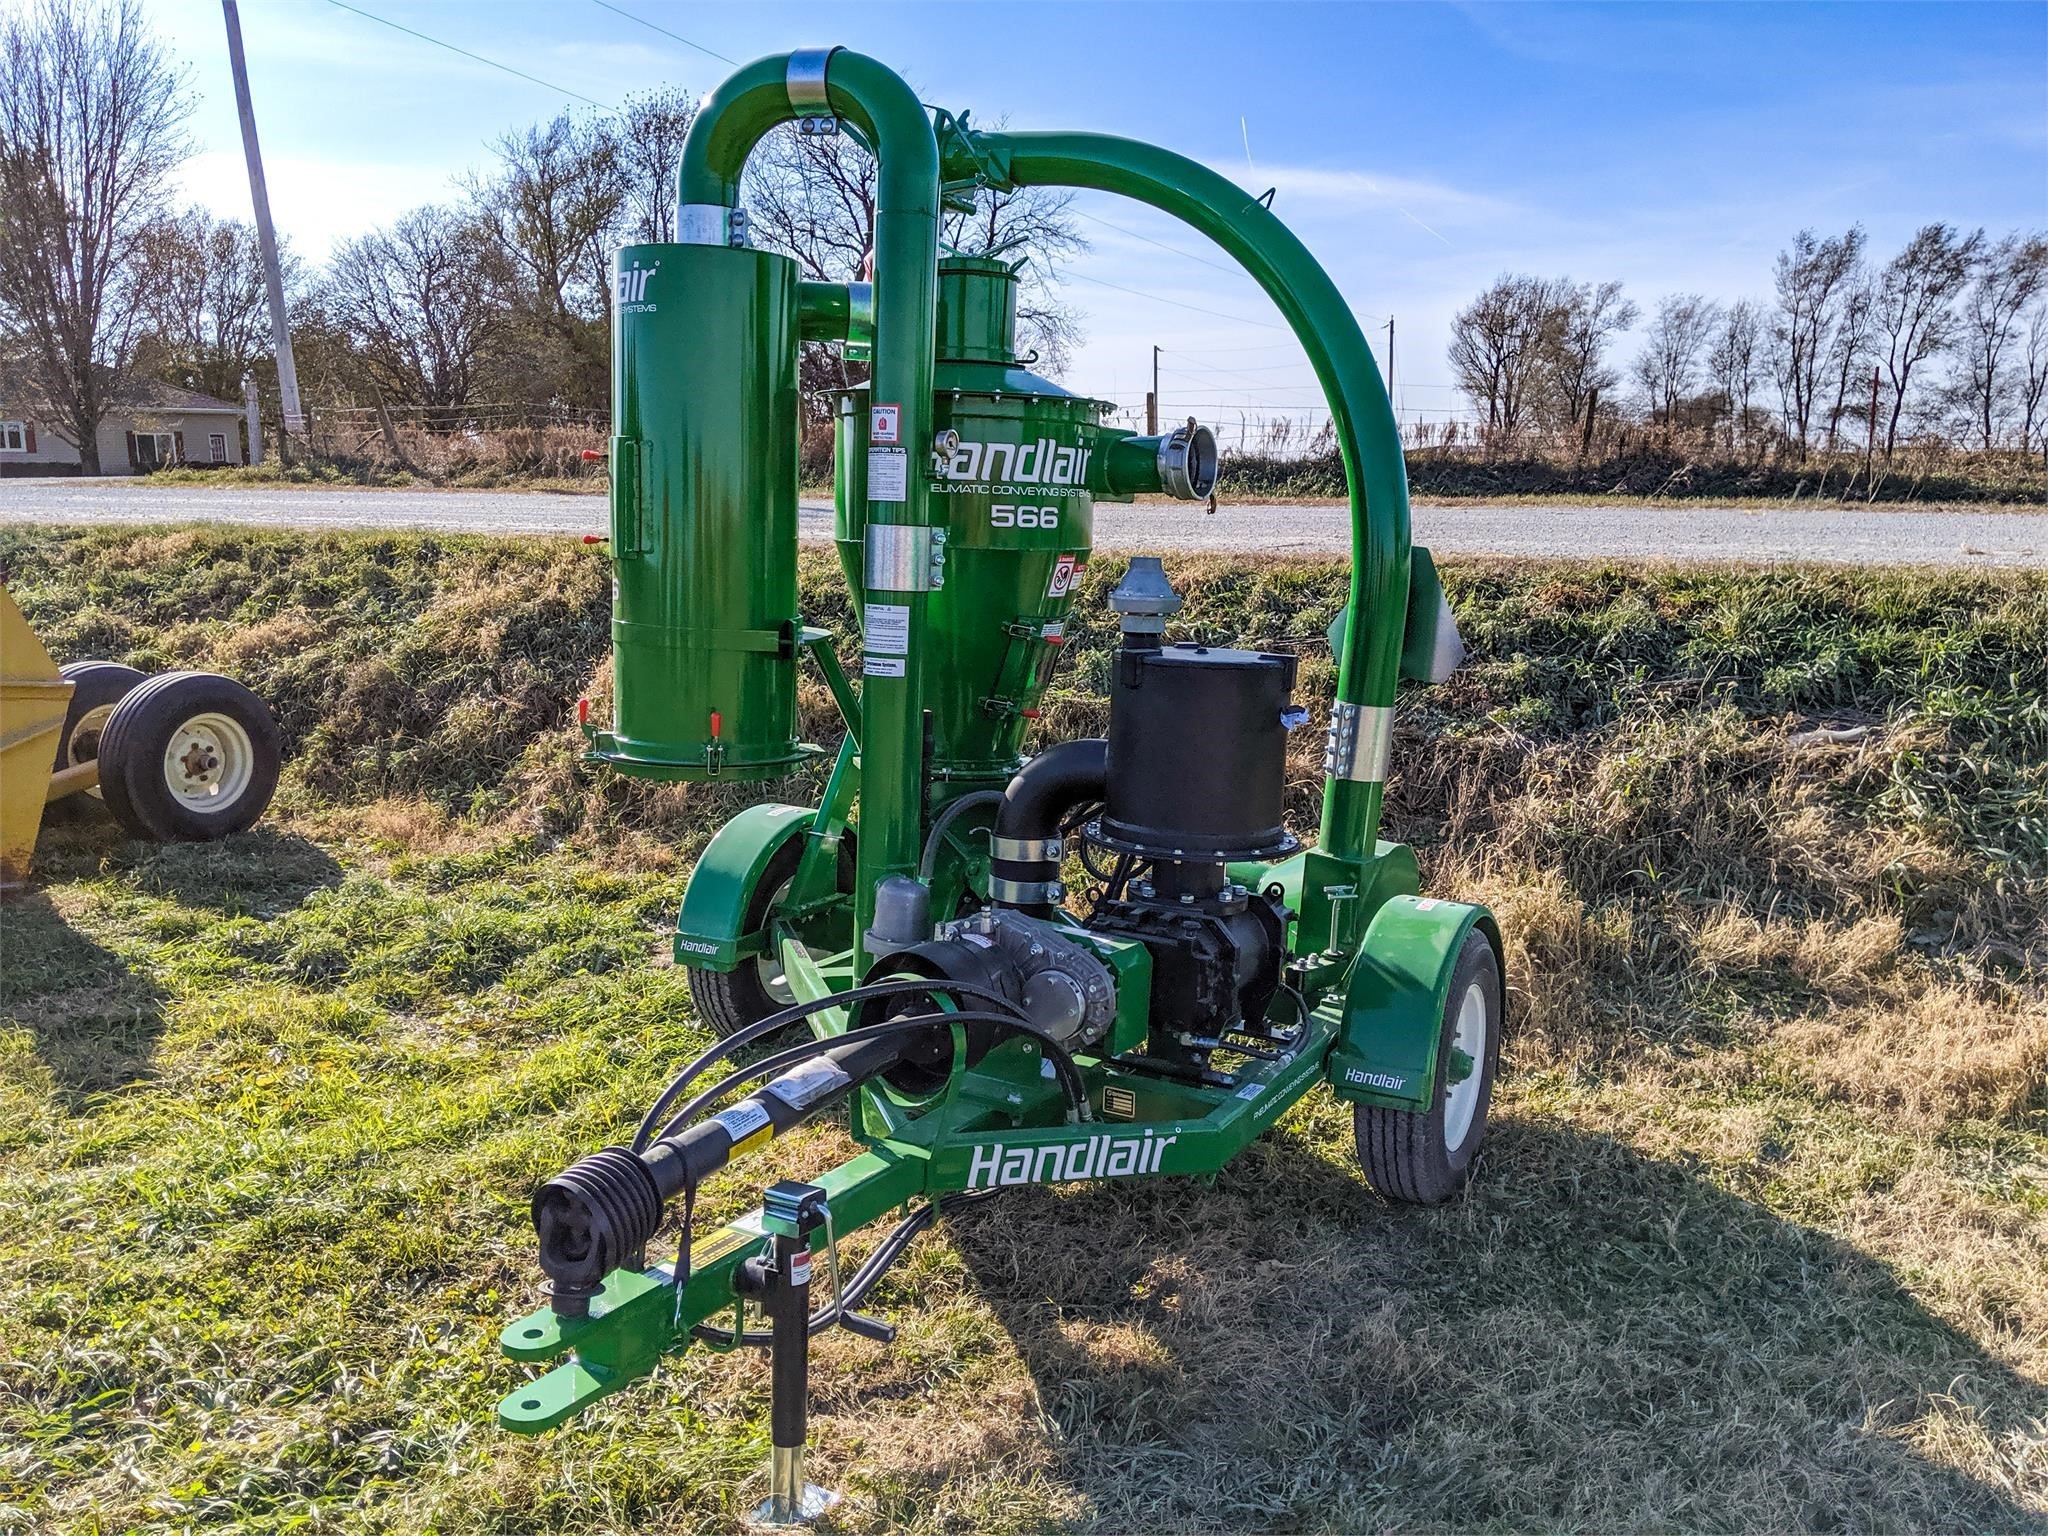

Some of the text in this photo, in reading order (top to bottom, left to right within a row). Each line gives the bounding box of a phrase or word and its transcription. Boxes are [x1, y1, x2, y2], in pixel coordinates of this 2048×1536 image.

[992, 485, 1059, 497] CONVEYING
[990, 504, 1059, 529] 566
[681, 939, 719, 955] Handlair
[1345, 1068, 1407, 1090] Handlair
[967, 1128, 1177, 1189] Handlair
